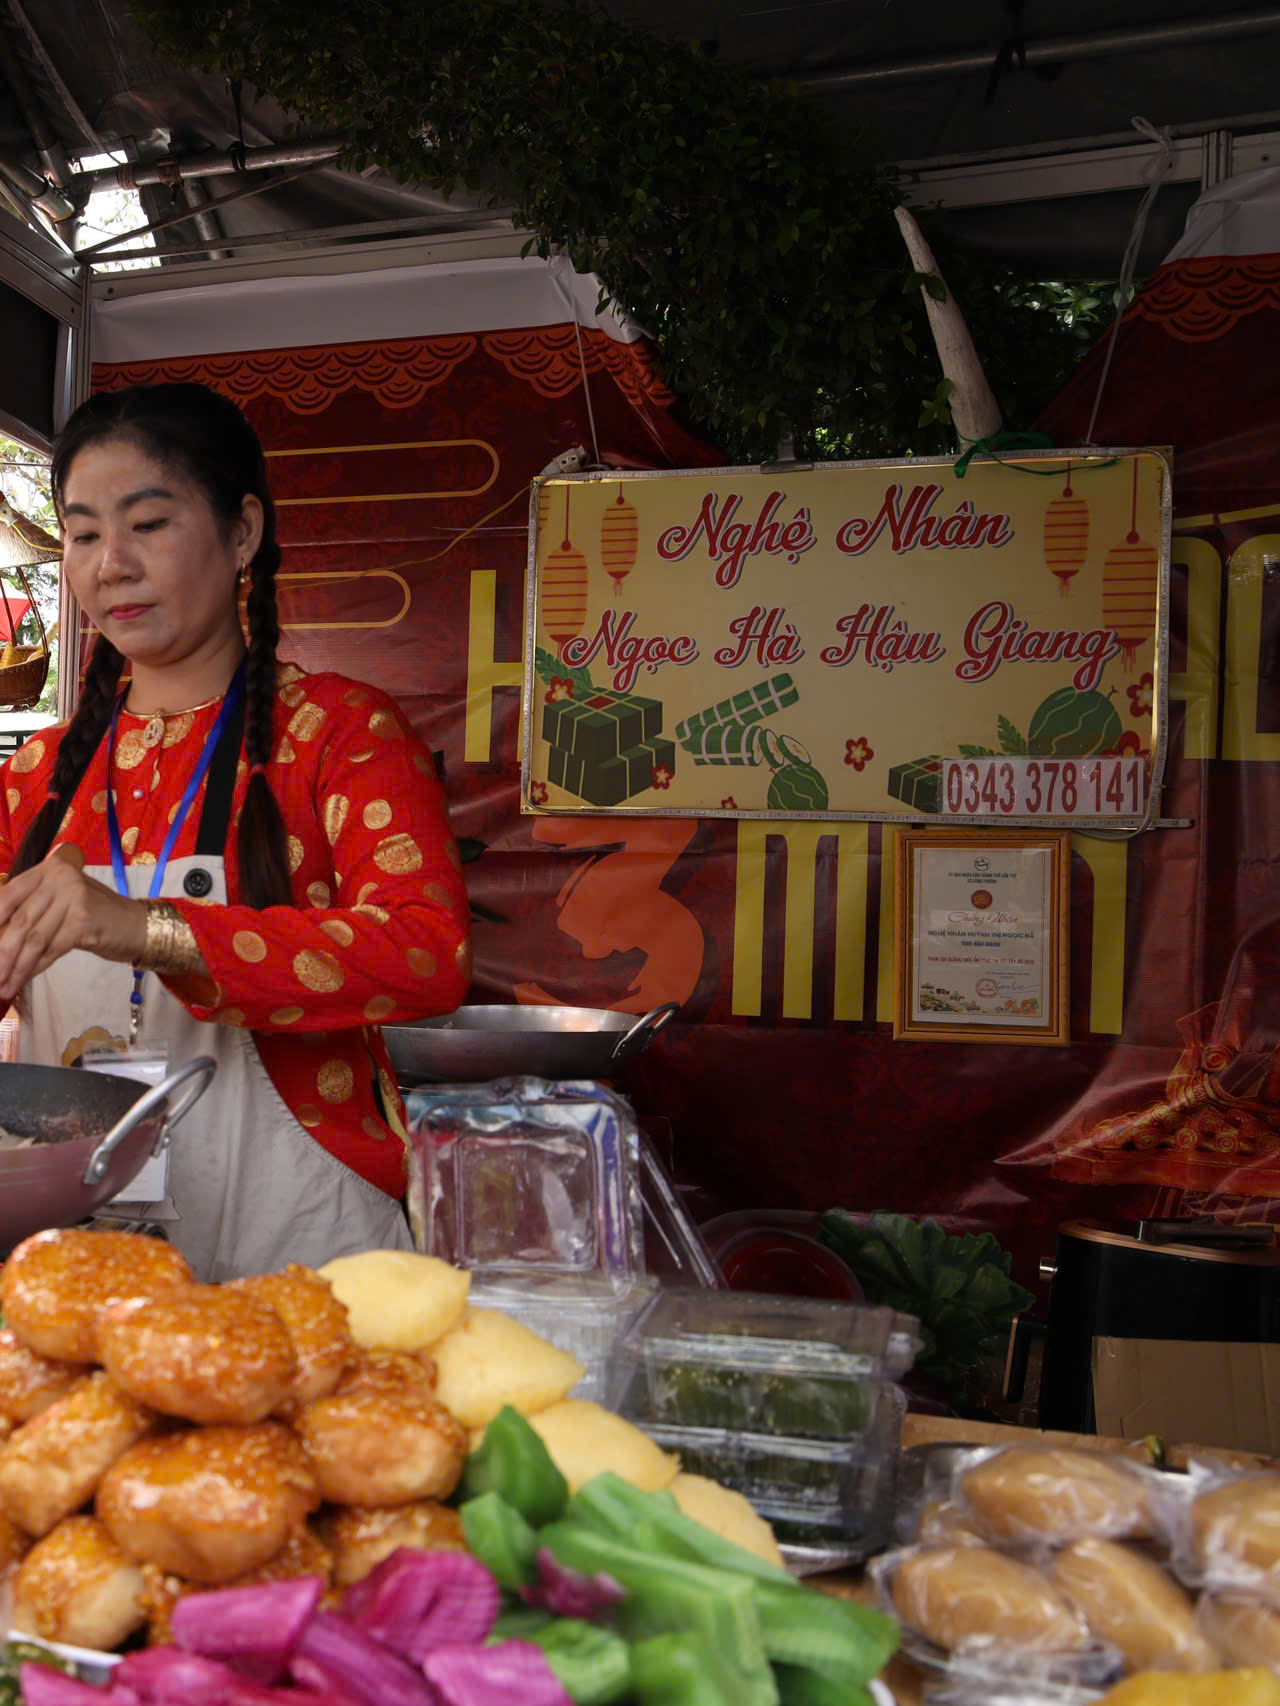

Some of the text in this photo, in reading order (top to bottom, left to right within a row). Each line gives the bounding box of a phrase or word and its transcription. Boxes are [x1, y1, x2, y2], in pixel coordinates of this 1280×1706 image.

[656, 483, 1015, 589] Nghệ Nhân
[562, 608, 699, 693] Ngọc
[714, 605, 804, 668] Hà
[819, 603, 946, 673] Hậu
[954, 600, 1121, 691] Giang
[947, 760, 1139, 813] 0343 378 141
